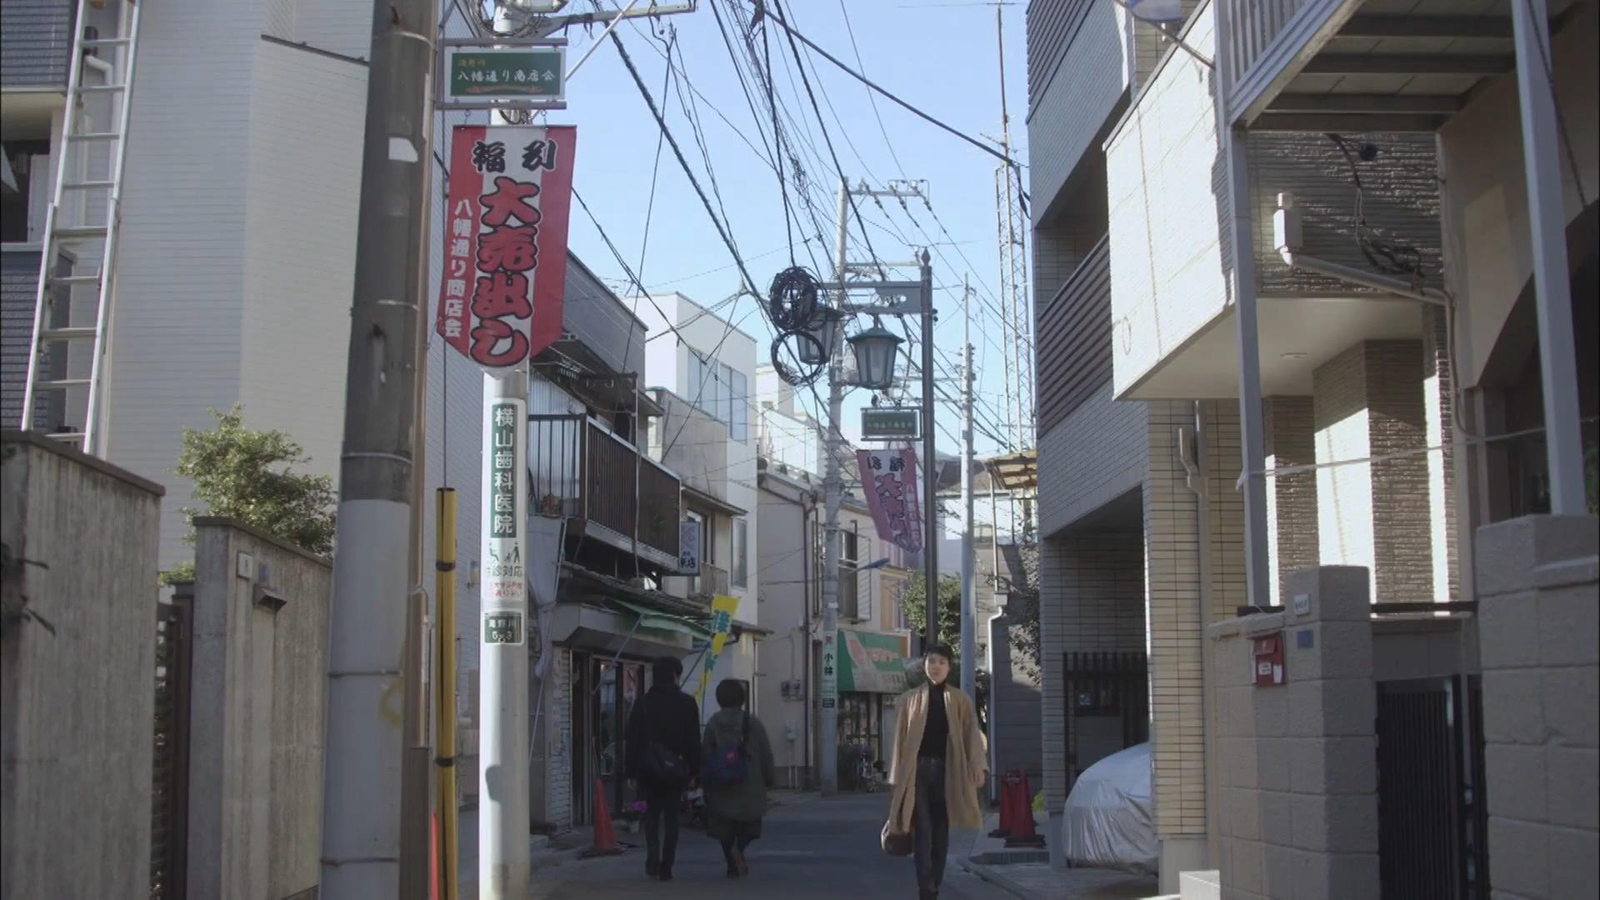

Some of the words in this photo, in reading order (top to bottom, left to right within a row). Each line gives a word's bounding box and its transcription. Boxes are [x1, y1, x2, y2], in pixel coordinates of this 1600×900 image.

[457, 69, 556, 82] 八幡通り商店会
[471, 140, 558, 173] 福引
[445, 199, 472, 338] 八幡通り商店会
[469, 176, 541, 368] 大売出し
[494, 408, 514, 534] 横山歯科医院
